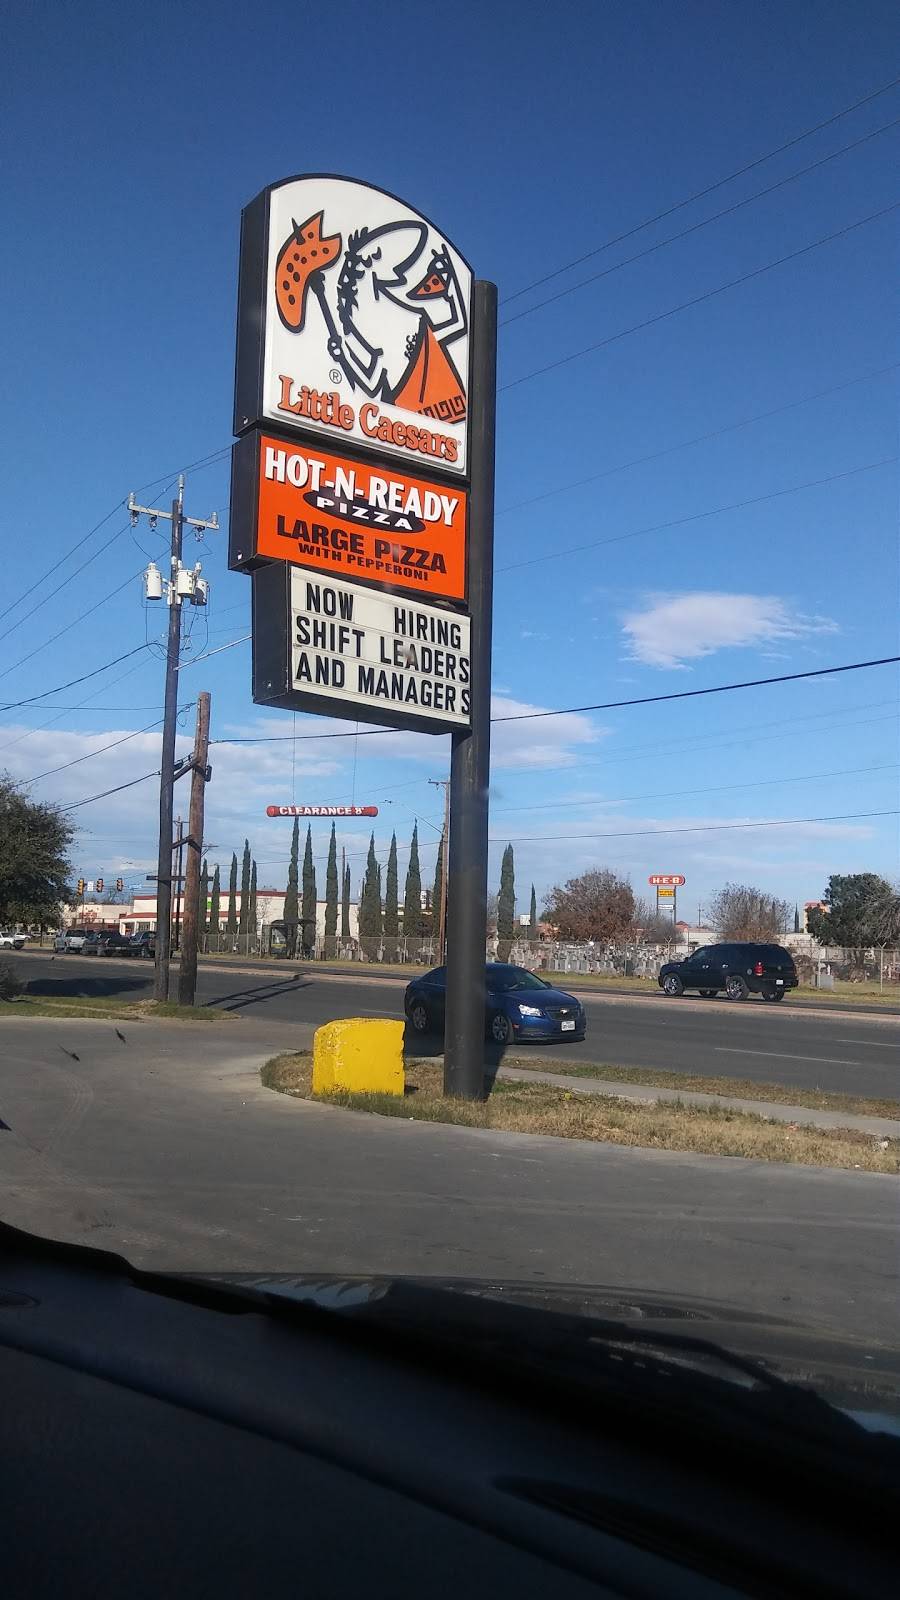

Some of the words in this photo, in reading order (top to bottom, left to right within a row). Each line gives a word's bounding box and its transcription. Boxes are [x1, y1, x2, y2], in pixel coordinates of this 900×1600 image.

[278, 374, 355, 431] Little
[359, 403, 460, 463] Caesars
[265, 446, 459, 527] HOT-N-READY
[316, 495, 414, 531] PIZZA
[277, 515, 365, 555] LARGE
[374, 538, 447, 574] PIZZA
[298, 542, 343, 562] WITH
[346, 554, 430, 582] PEPPERONI
[306, 582, 355, 621] NOW
[393, 606, 462, 650] HIRING
[296, 615, 366, 658] SHIFT
[379, 636, 470, 684] LEADERS
[296, 651, 346, 688] AND
[358, 665, 471, 715] MANAGERS
[279, 806, 353, 816] CLEARANCE
[652, 876, 680, 884] H-E-B
